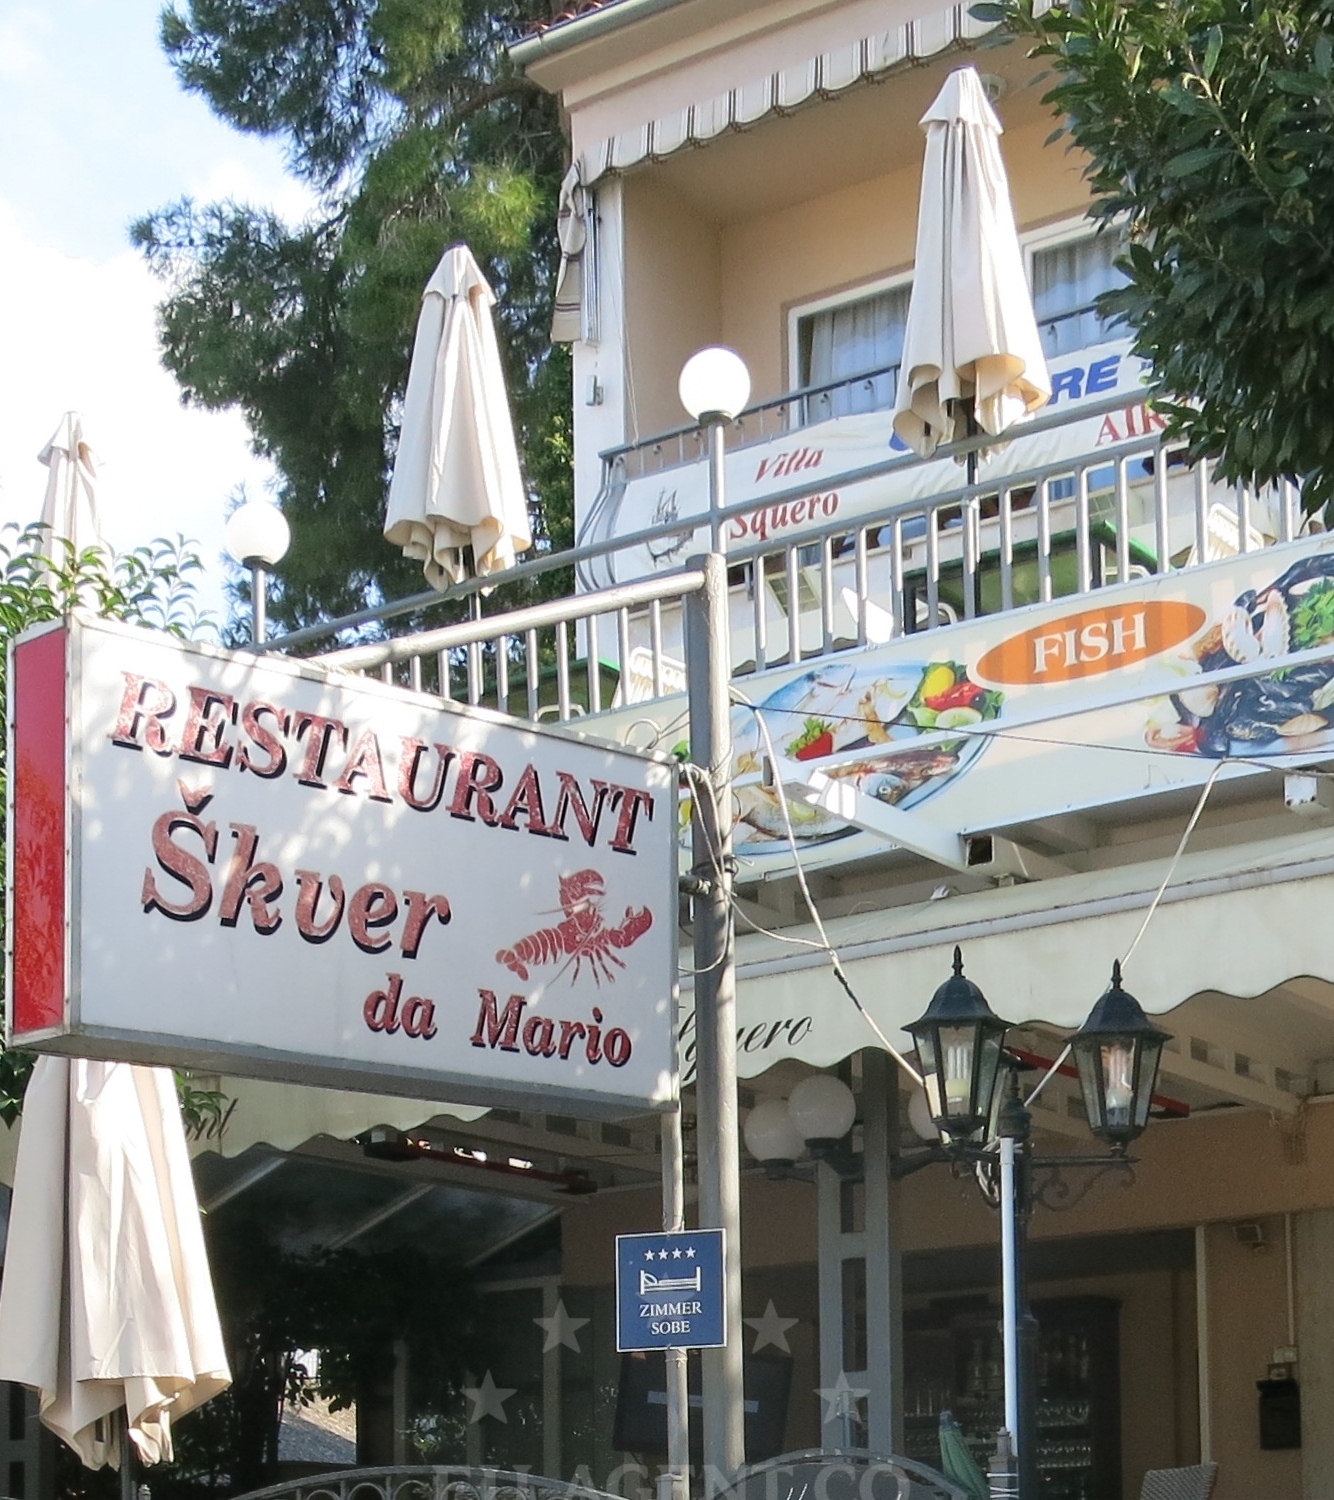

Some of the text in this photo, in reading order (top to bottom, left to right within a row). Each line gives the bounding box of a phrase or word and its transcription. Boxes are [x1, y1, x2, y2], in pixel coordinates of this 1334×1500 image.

[755, 447, 824, 483] Villa
[730, 492, 839, 542] Squero
[1032, 612, 1148, 675] FISH
[107, 670, 654, 856] RESTAURANT
[141, 778, 452, 960] Škver
[363, 973, 632, 1068] da Mario
[639, 1301, 702, 1318] ZIMMER
[650, 1319, 691, 1336] SOBE
